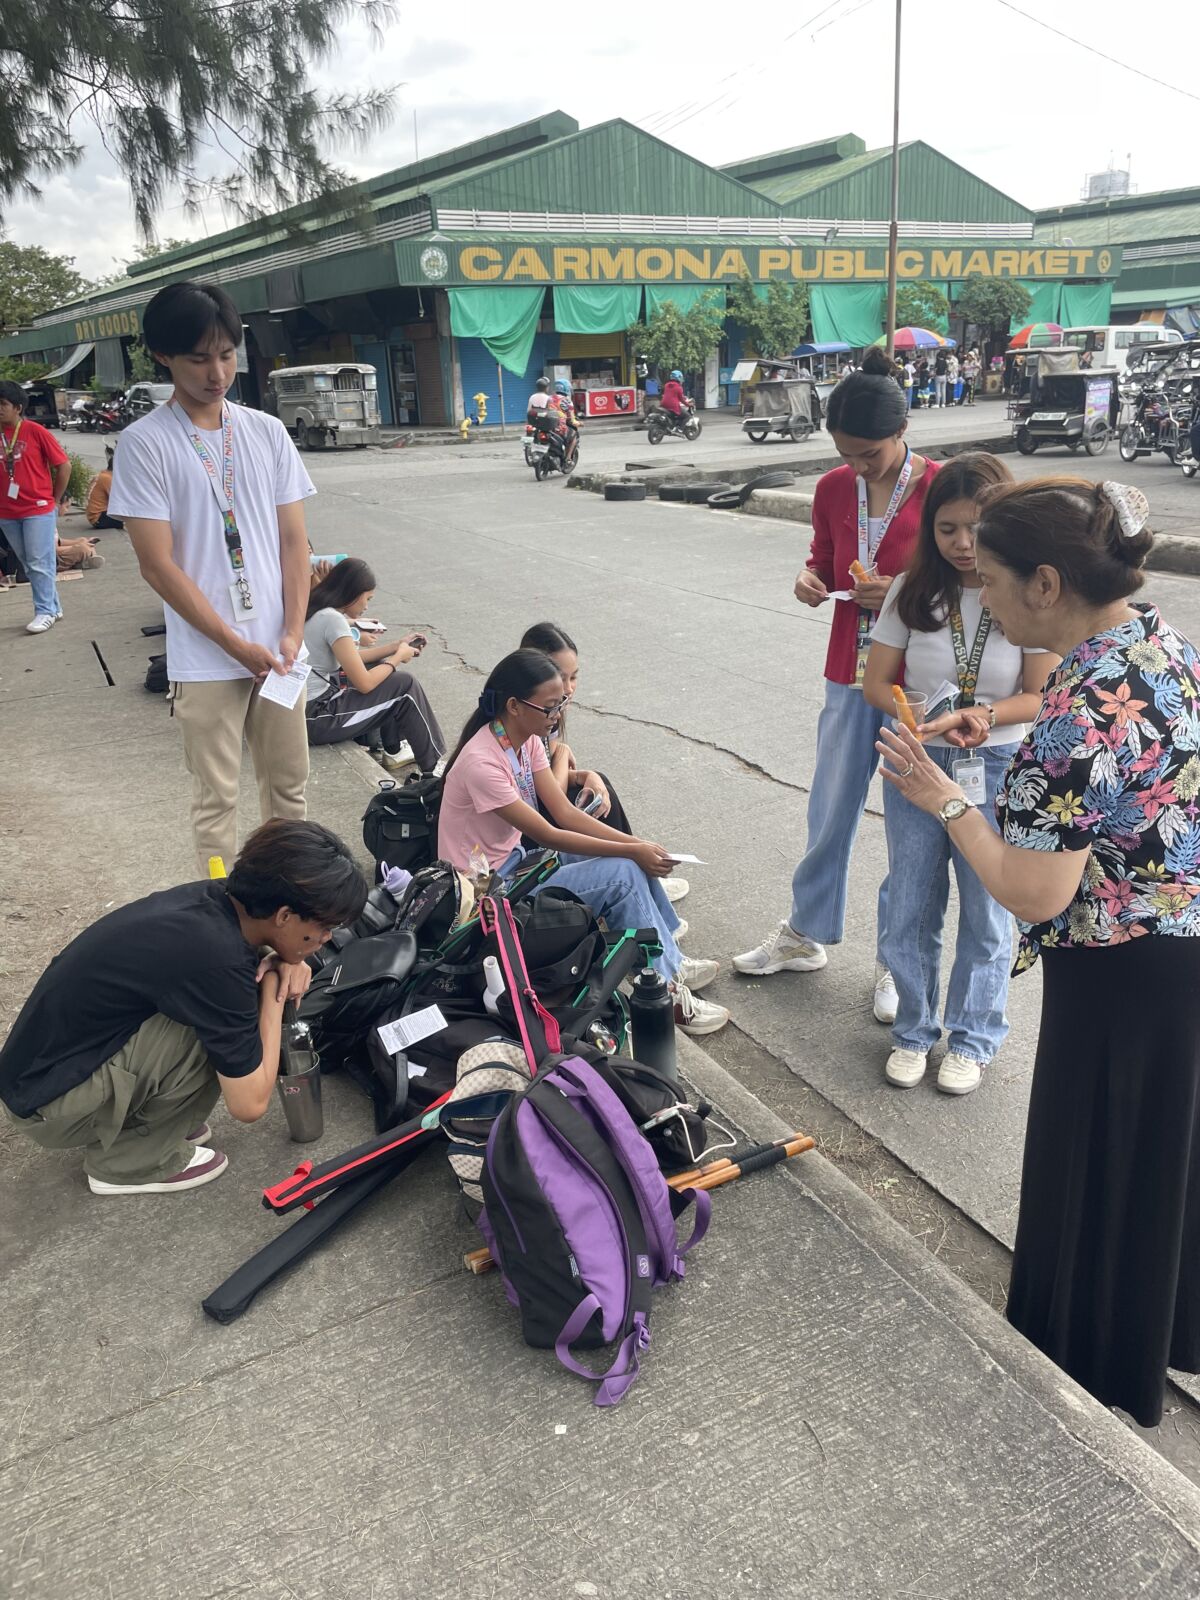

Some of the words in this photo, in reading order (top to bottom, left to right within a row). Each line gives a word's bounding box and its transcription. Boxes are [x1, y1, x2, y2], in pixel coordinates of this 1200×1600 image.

[459, 246, 751, 281] CARMONA
[931, 250, 1093, 277] MARKET
[75, 320, 96, 341] DRY
[98, 309, 139, 337] GOODS
[884, 468, 911, 524] MANAGEMENT
[967, 644, 983, 677] CAVITE
[977, 613, 991, 643] STATE
